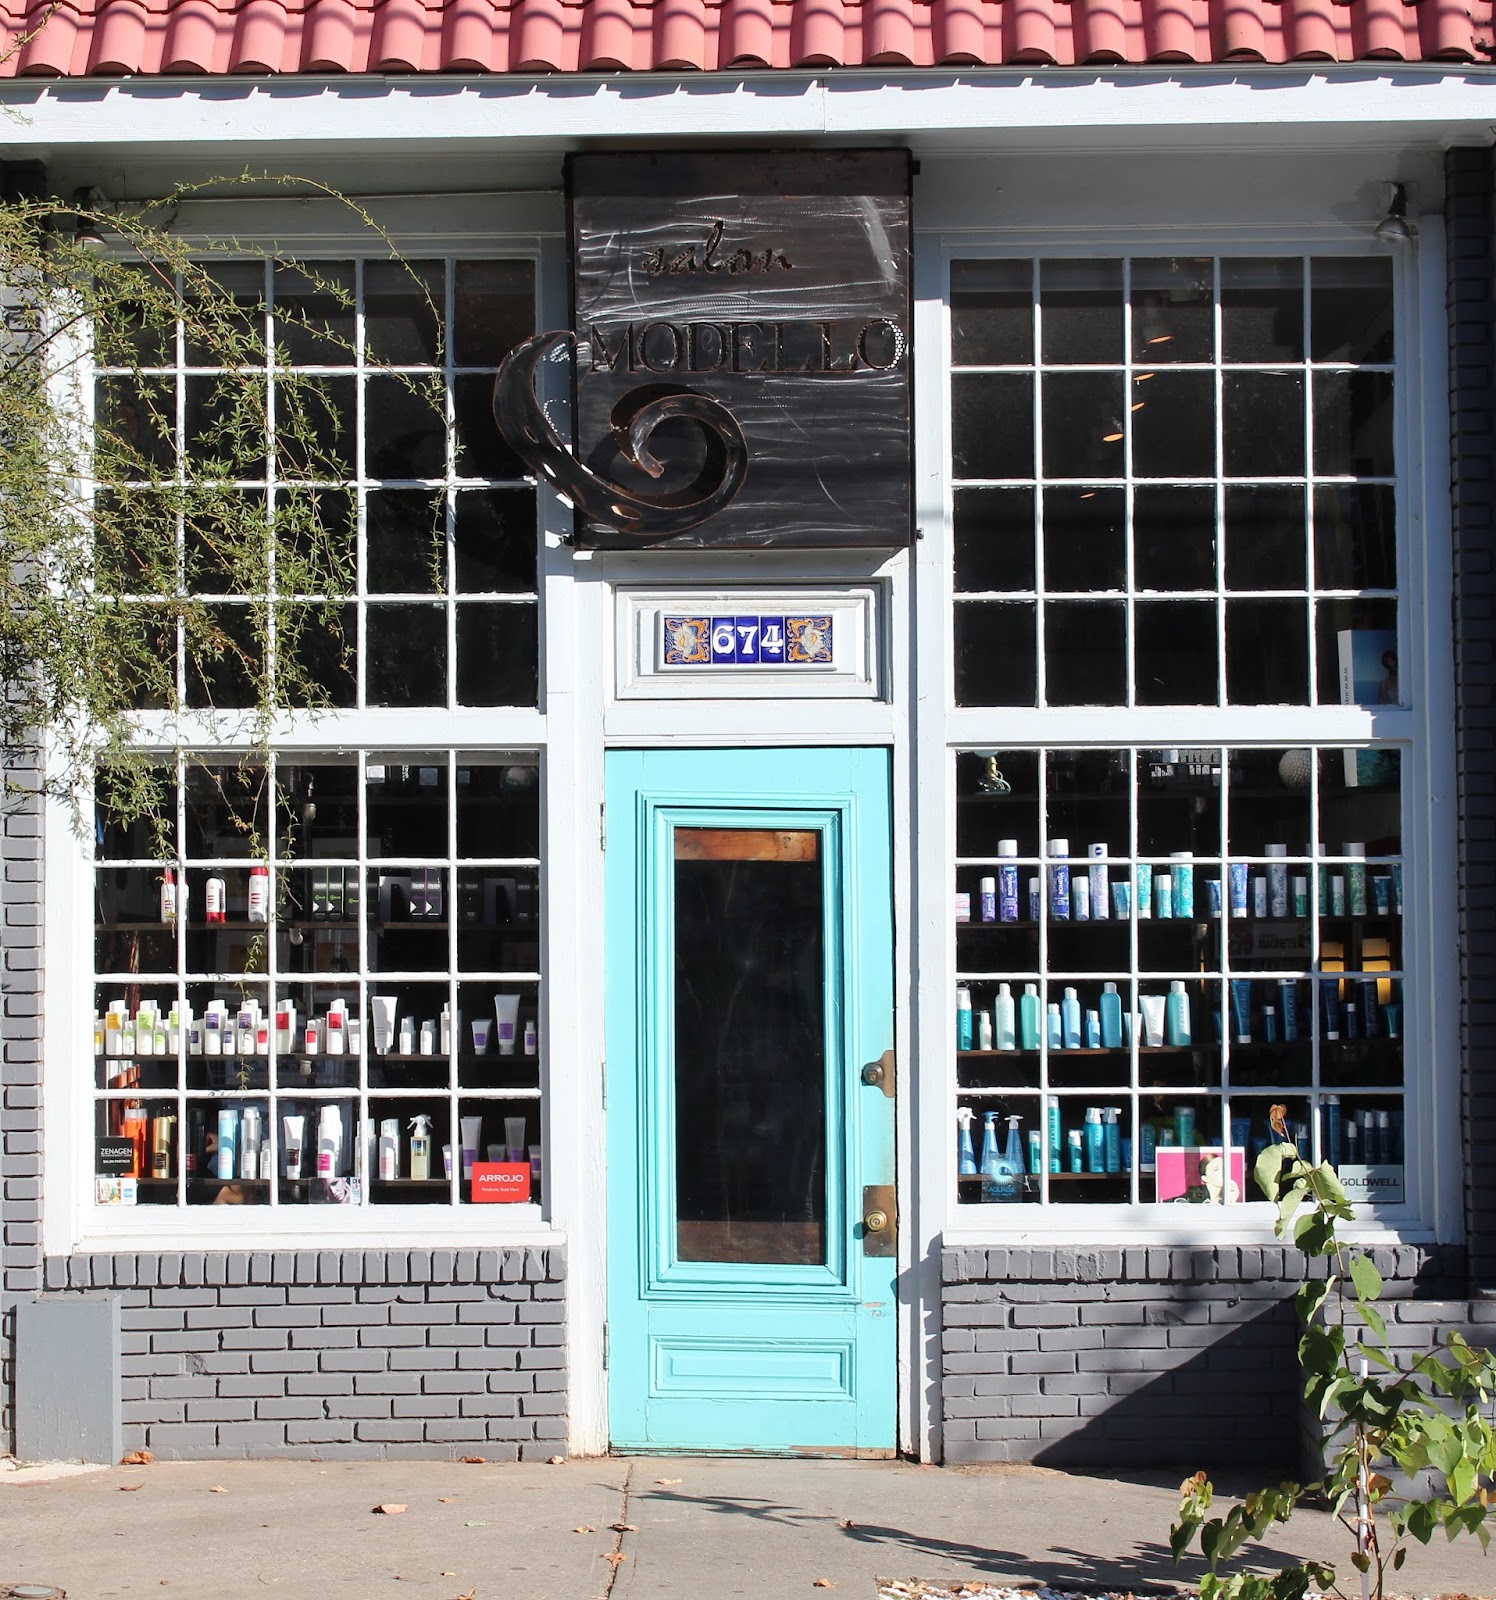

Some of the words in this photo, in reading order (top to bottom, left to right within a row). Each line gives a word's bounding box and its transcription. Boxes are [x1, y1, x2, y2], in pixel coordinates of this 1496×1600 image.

[641, 219, 793, 276] salon
[586, 317, 905, 374] MODELLO
[711, 625, 784, 655] 674
[101, 1147, 132, 1155] ZENAGEN
[479, 1174, 524, 1183] ARROJO
[1340, 1177, 1400, 1187] GOLDWELL
